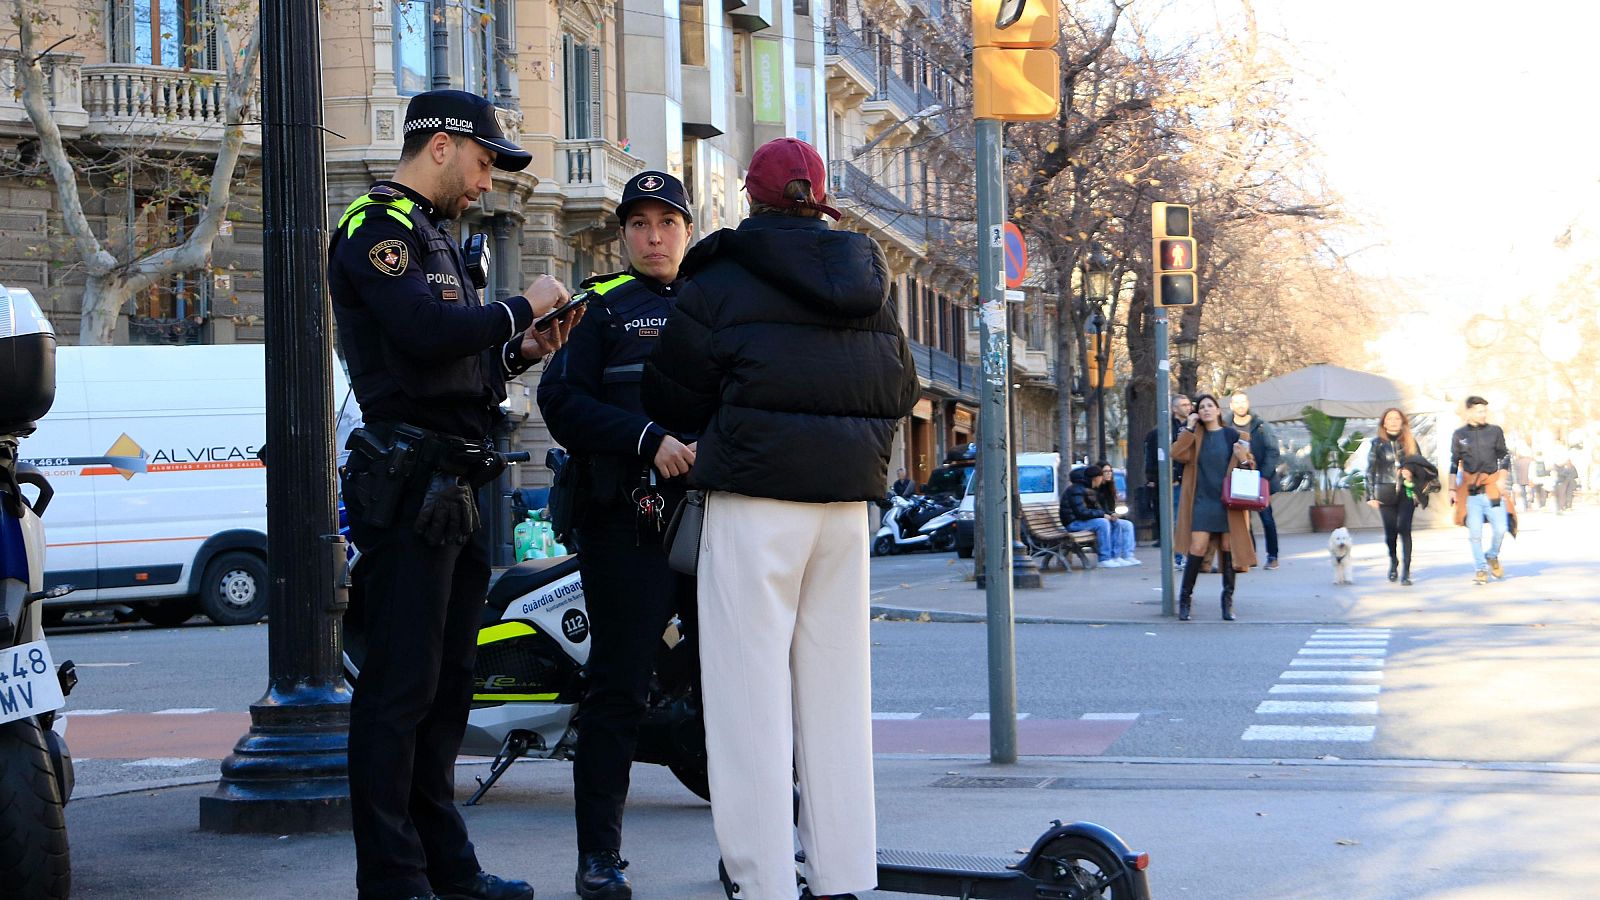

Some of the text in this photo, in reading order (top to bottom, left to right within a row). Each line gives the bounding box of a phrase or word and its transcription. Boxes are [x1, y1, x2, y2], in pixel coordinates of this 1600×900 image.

[445, 117, 473, 129] POLICIA
[522, 593, 554, 614] Guàrdia
[564, 615, 584, 632] 112
